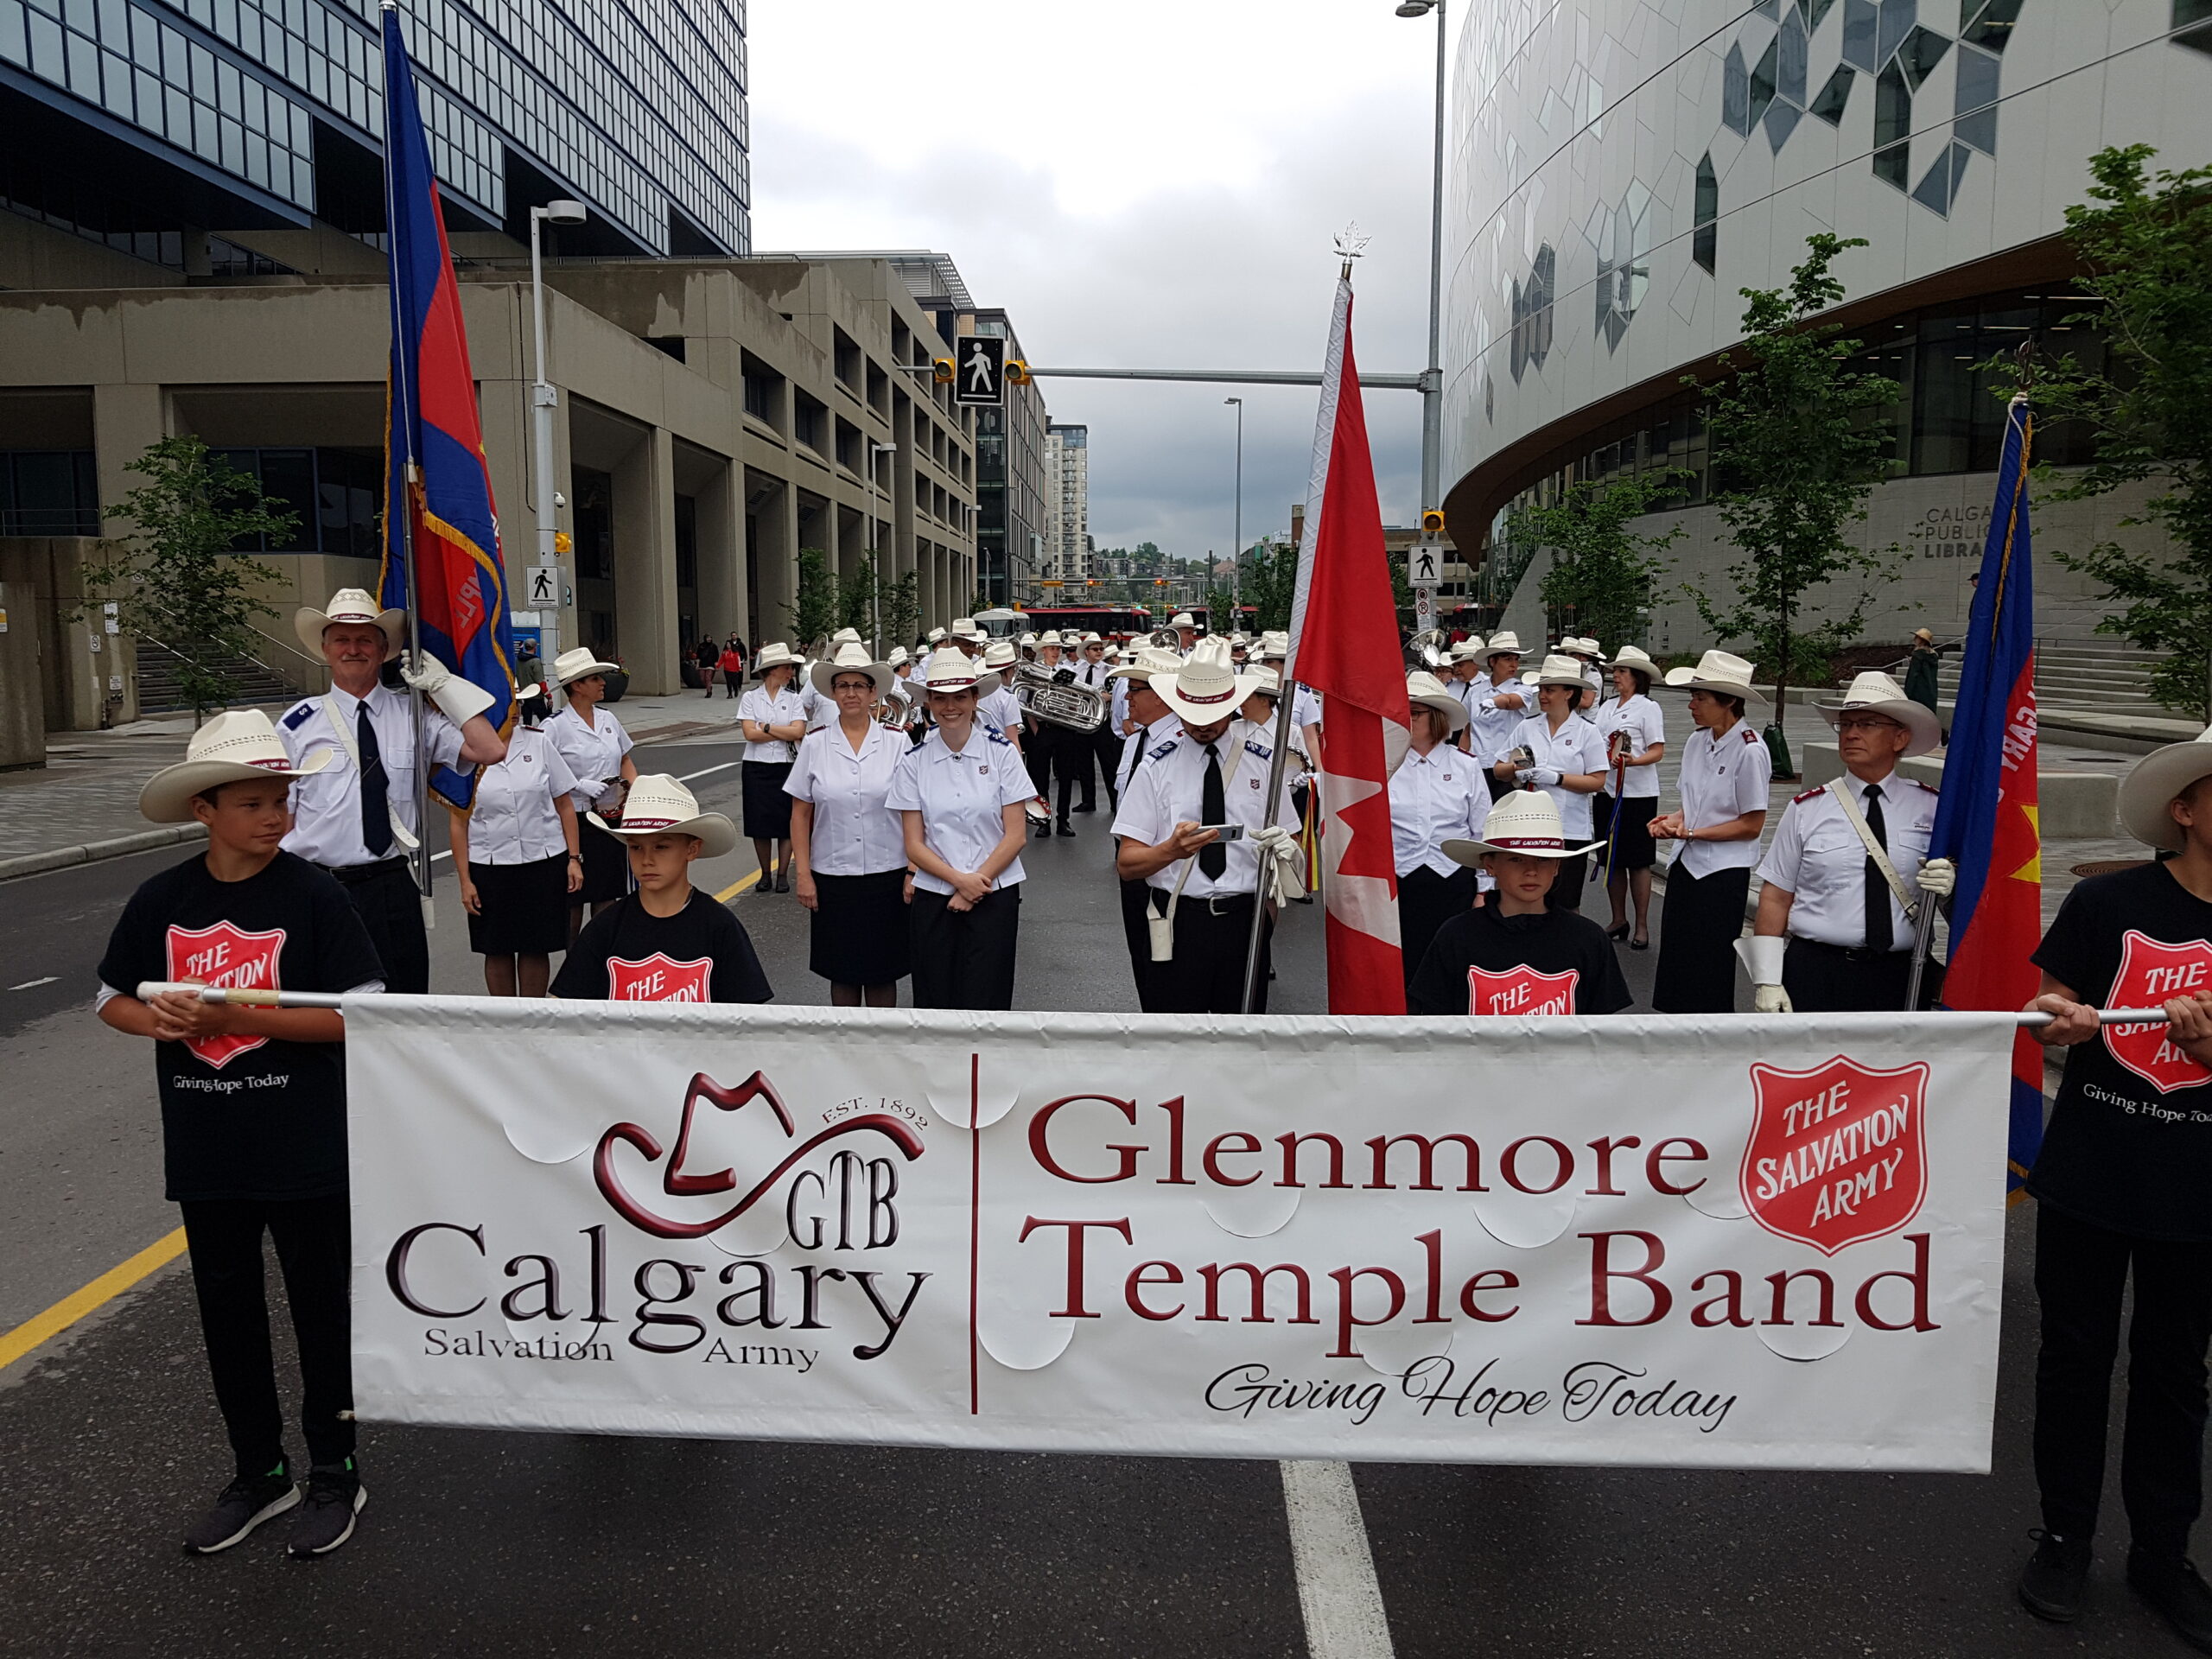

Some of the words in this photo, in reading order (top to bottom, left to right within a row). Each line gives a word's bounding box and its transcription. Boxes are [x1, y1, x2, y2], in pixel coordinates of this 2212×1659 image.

[1926, 505, 1992, 523] CALGA
[1923, 542, 1983, 559] LIBRA
[186, 940, 232, 977] THE
[2145, 961, 2209, 995] THE
[626, 969, 667, 1001] THE
[1489, 982, 1533, 1015] THE
[173, 1075, 213, 1092] Giving
[245, 1074, 289, 1088] Today
[2082, 1083, 2138, 1115] Giving
[2140, 1101, 2187, 1123] Hope
[822, 1096, 868, 1124] EST.
[880, 1096, 929, 1131] 1892
[1782, 1079, 1851, 1138] THE
[1027, 1093, 1710, 1198] Glenmore
[1756, 1094, 1910, 1200] SALVATION
[786, 1149, 901, 1251] GTB
[1808, 1147, 1904, 1229] ARMY
[385, 1221, 934, 1361] Calgary
[1017, 1214, 1522, 1358] Temple
[1573, 1229, 1942, 1333] Band
[423, 1326, 615, 1362] Salvation
[702, 1336, 820, 1373] Army
[1204, 1362, 1387, 1426] Giving
[1401, 1354, 1552, 1428] Hope
[1560, 1360, 1738, 1434] Today
